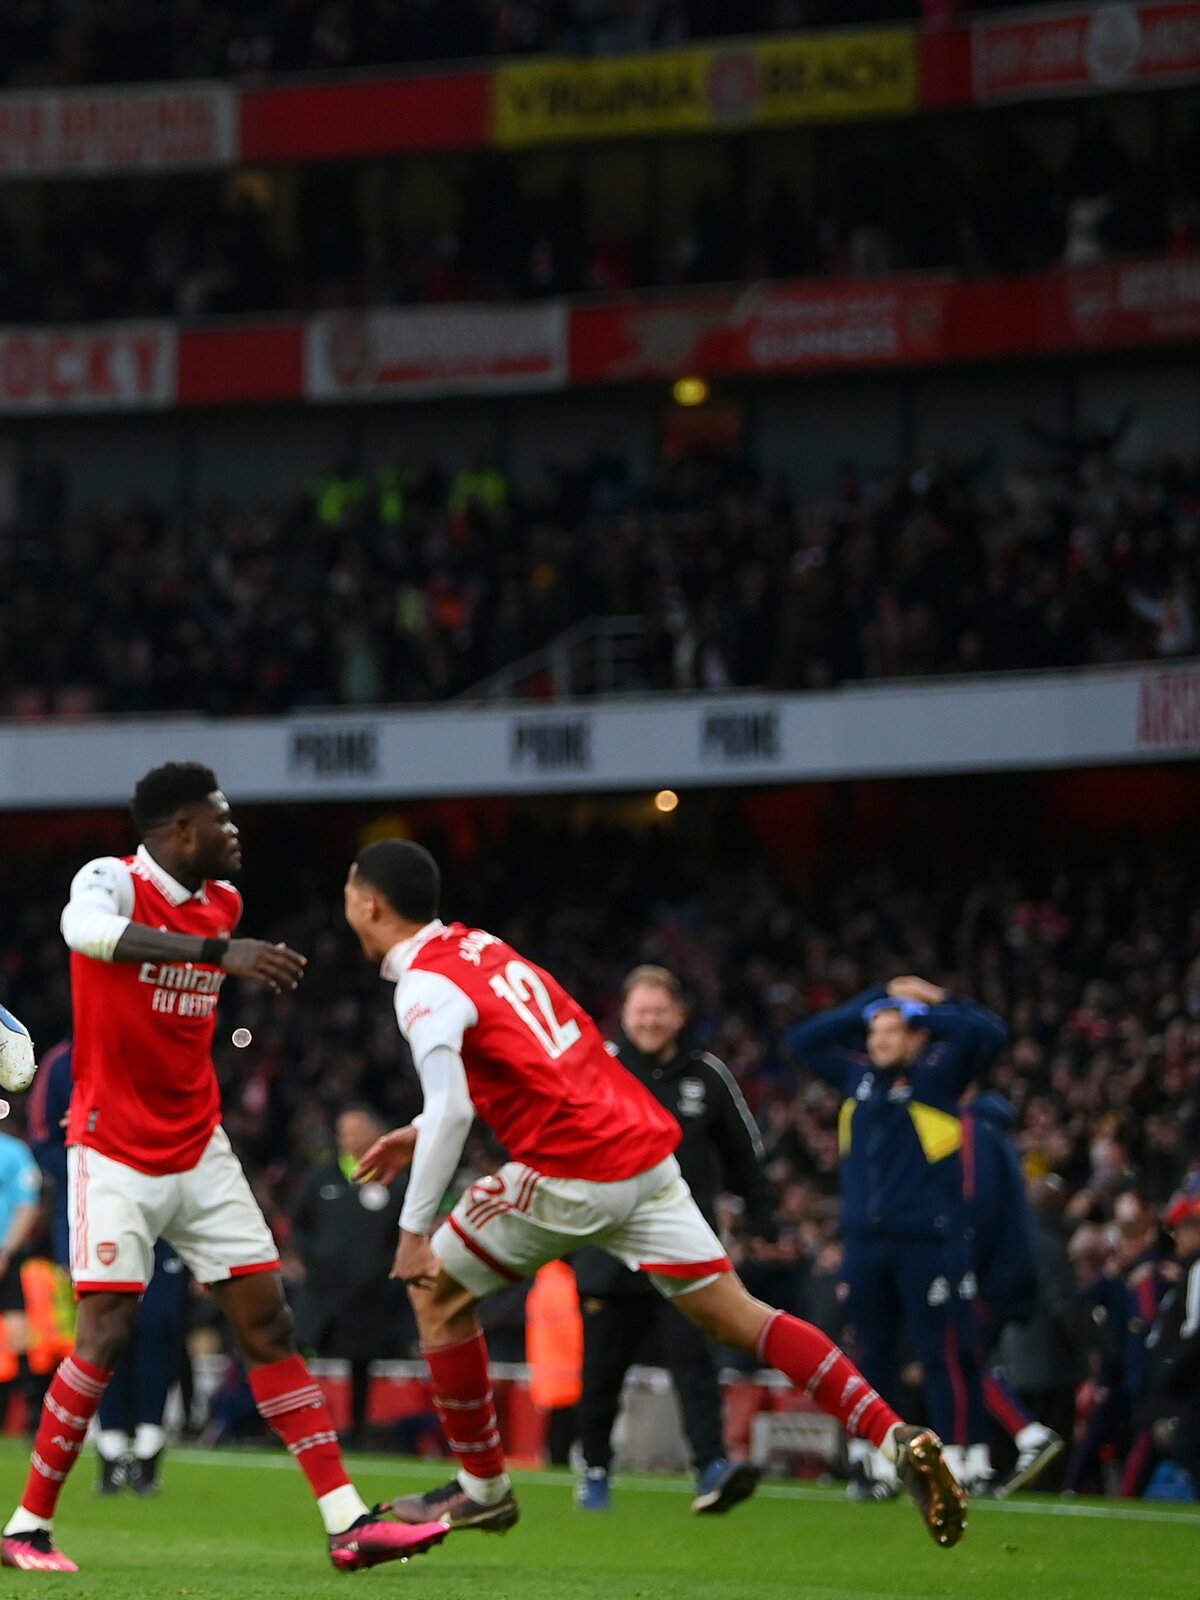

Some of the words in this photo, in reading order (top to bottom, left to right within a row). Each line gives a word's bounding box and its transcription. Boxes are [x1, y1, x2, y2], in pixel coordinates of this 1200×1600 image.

[506, 68, 694, 122] VIRGINIA
[763, 45, 911, 94] BEACH
[290, 728, 379, 777] PRIME
[510, 720, 590, 772] PRIME
[702, 711, 783, 762] PRIME
[152, 987, 178, 1014] FLY
[488, 960, 583, 1060] 12
